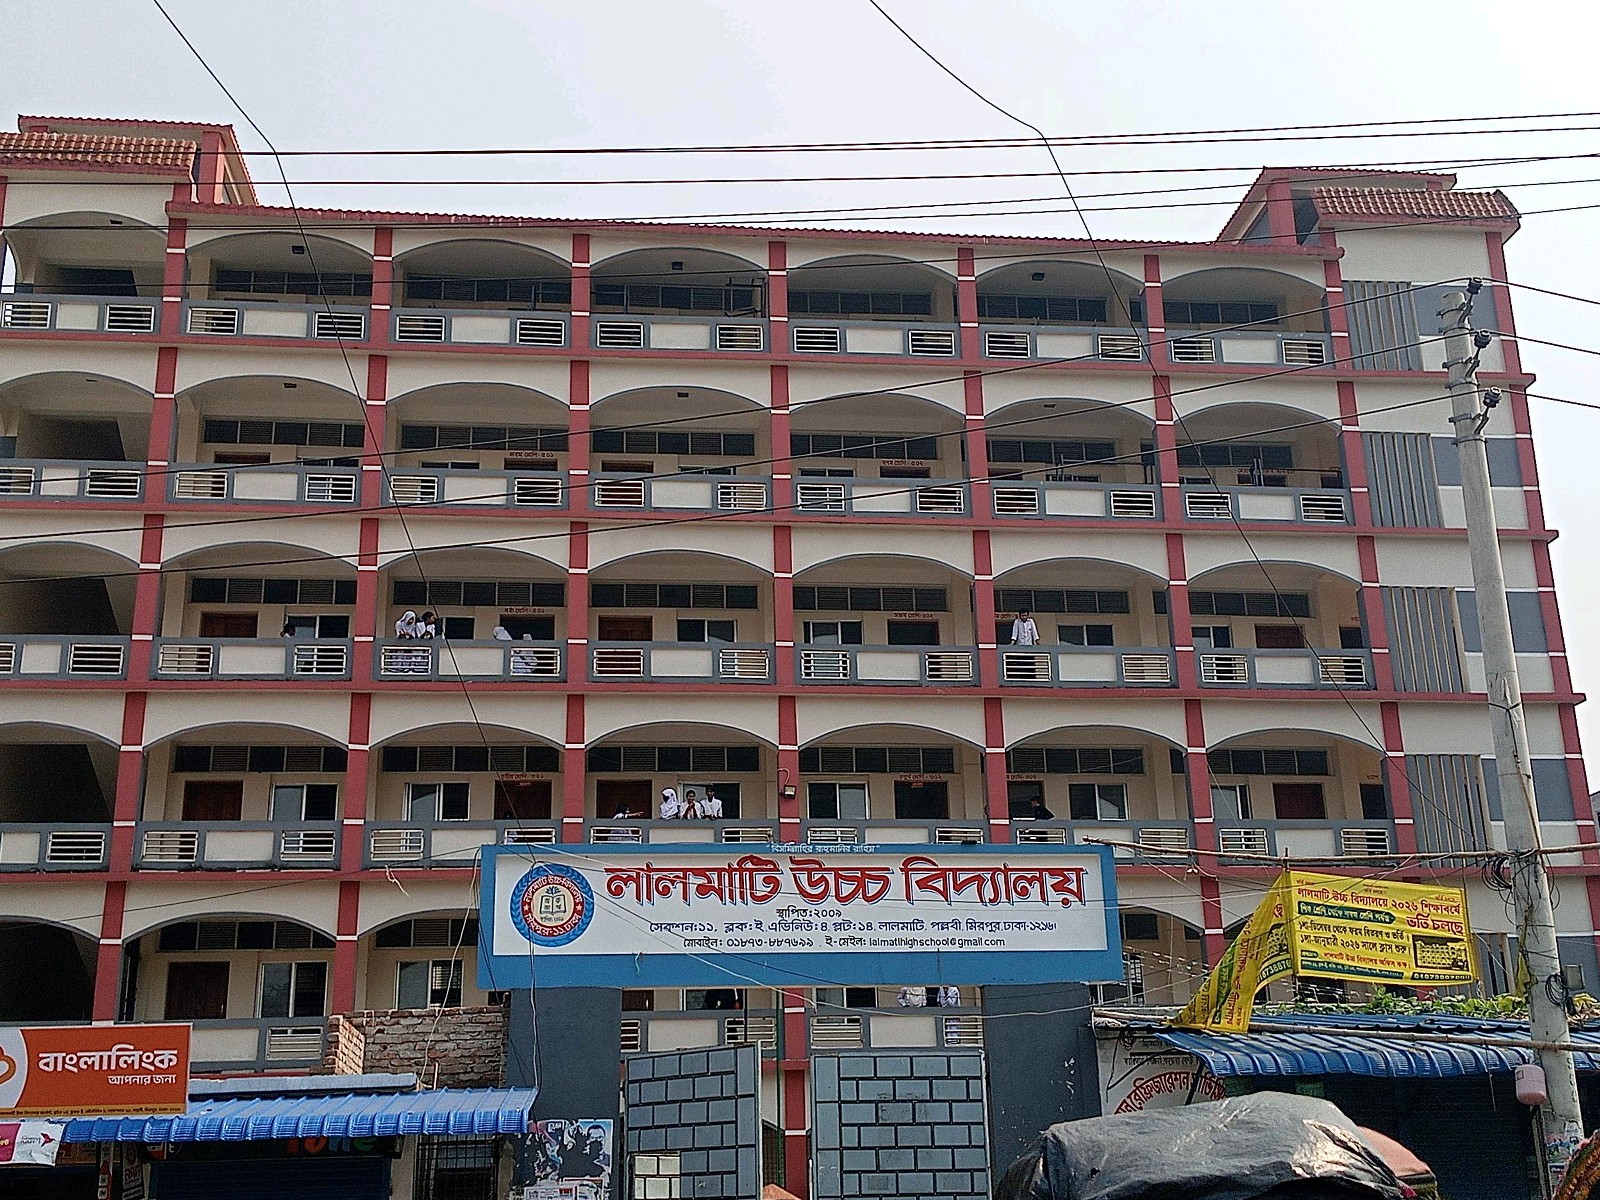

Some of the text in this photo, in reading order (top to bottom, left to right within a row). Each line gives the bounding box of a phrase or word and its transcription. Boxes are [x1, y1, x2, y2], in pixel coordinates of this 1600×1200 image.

[603, 855, 1088, 908] লালমাটি উচ্চ বিদ্যালয়
[1391, 899, 1418, 913] ২০২৬
[1431, 919, 1463, 935] চলছে
[38, 1043, 178, 1074] বাংলালিংক
[107, 1074, 177, 1086] আপনার জন্য
